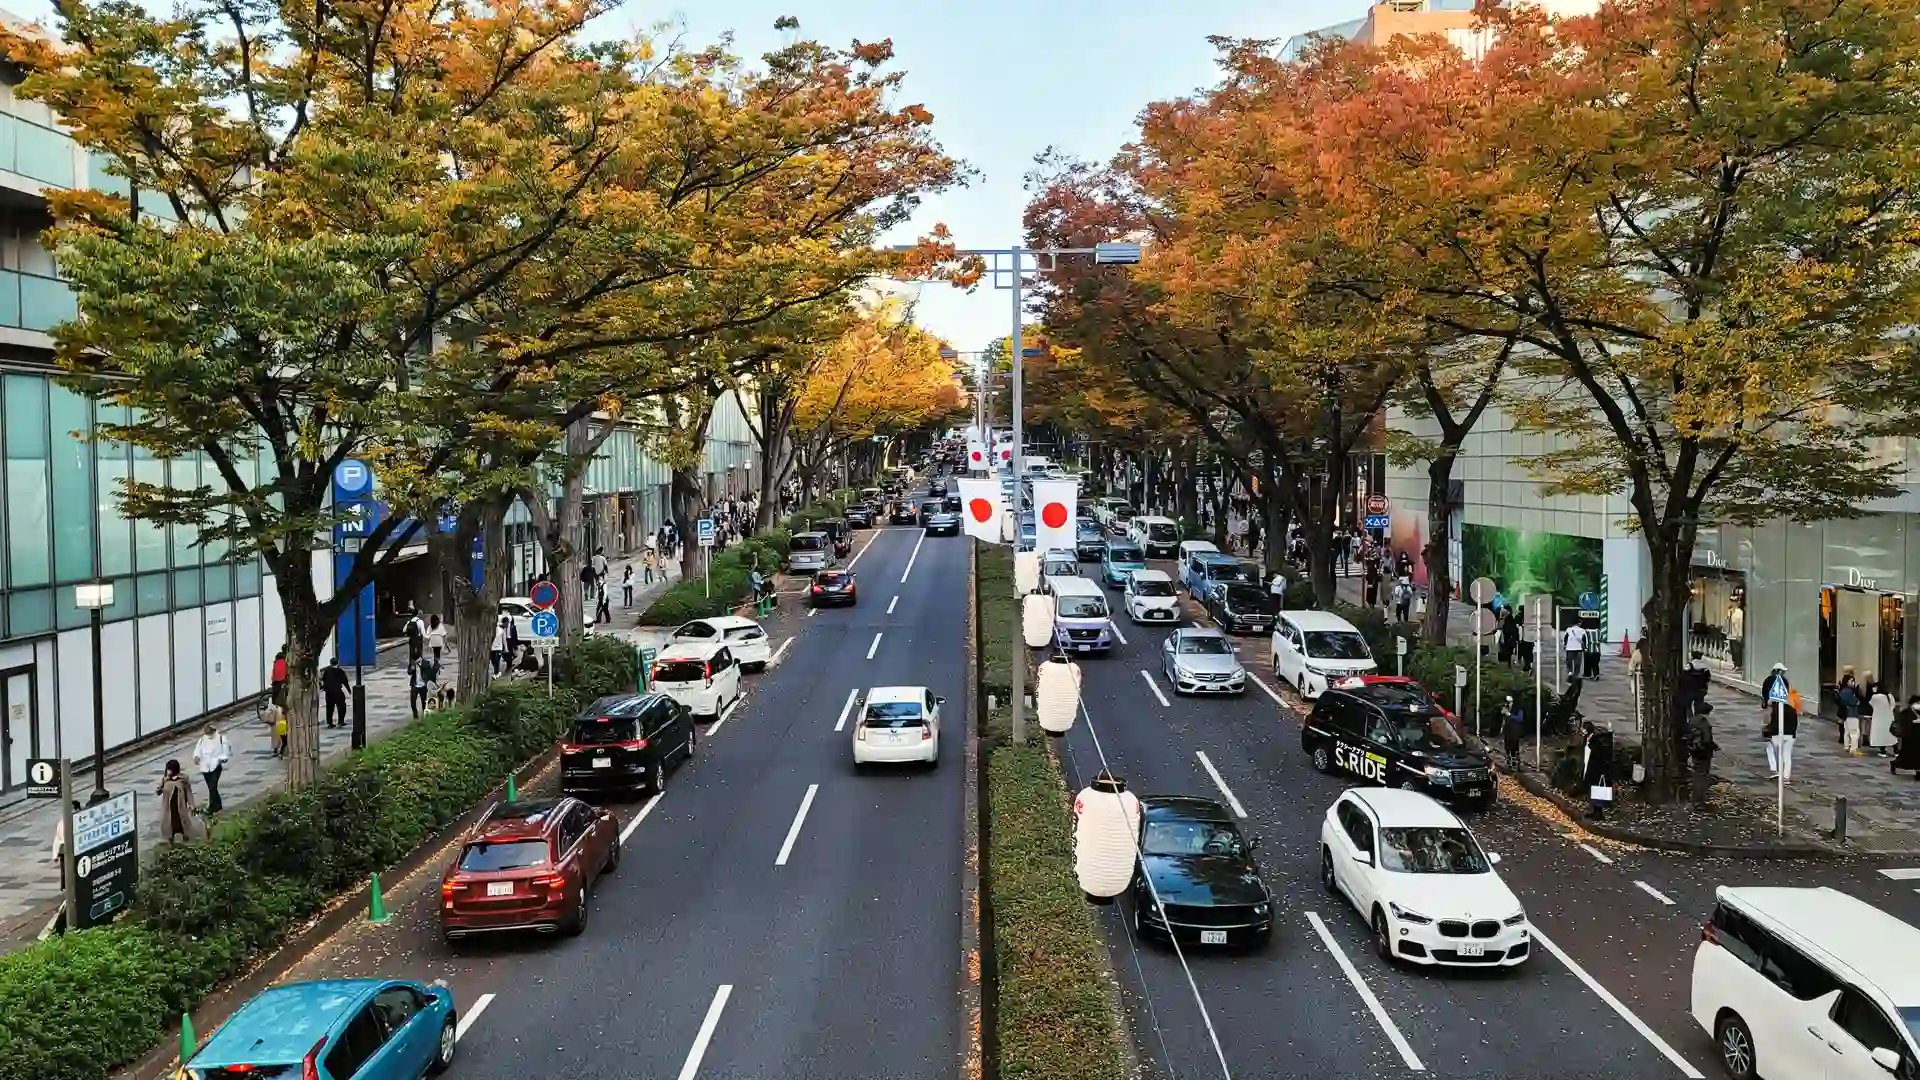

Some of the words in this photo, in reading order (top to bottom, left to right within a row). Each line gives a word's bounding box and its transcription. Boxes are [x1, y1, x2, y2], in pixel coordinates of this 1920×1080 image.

[343, 466, 361, 484] P
[342, 519, 364, 532] IN
[700, 521, 713, 534] P
[1707, 550, 1728, 567] Dior
[1849, 567, 1877, 589] Dior
[537, 618, 548, 635] P
[1335, 747, 1387, 785] S.RIDE
